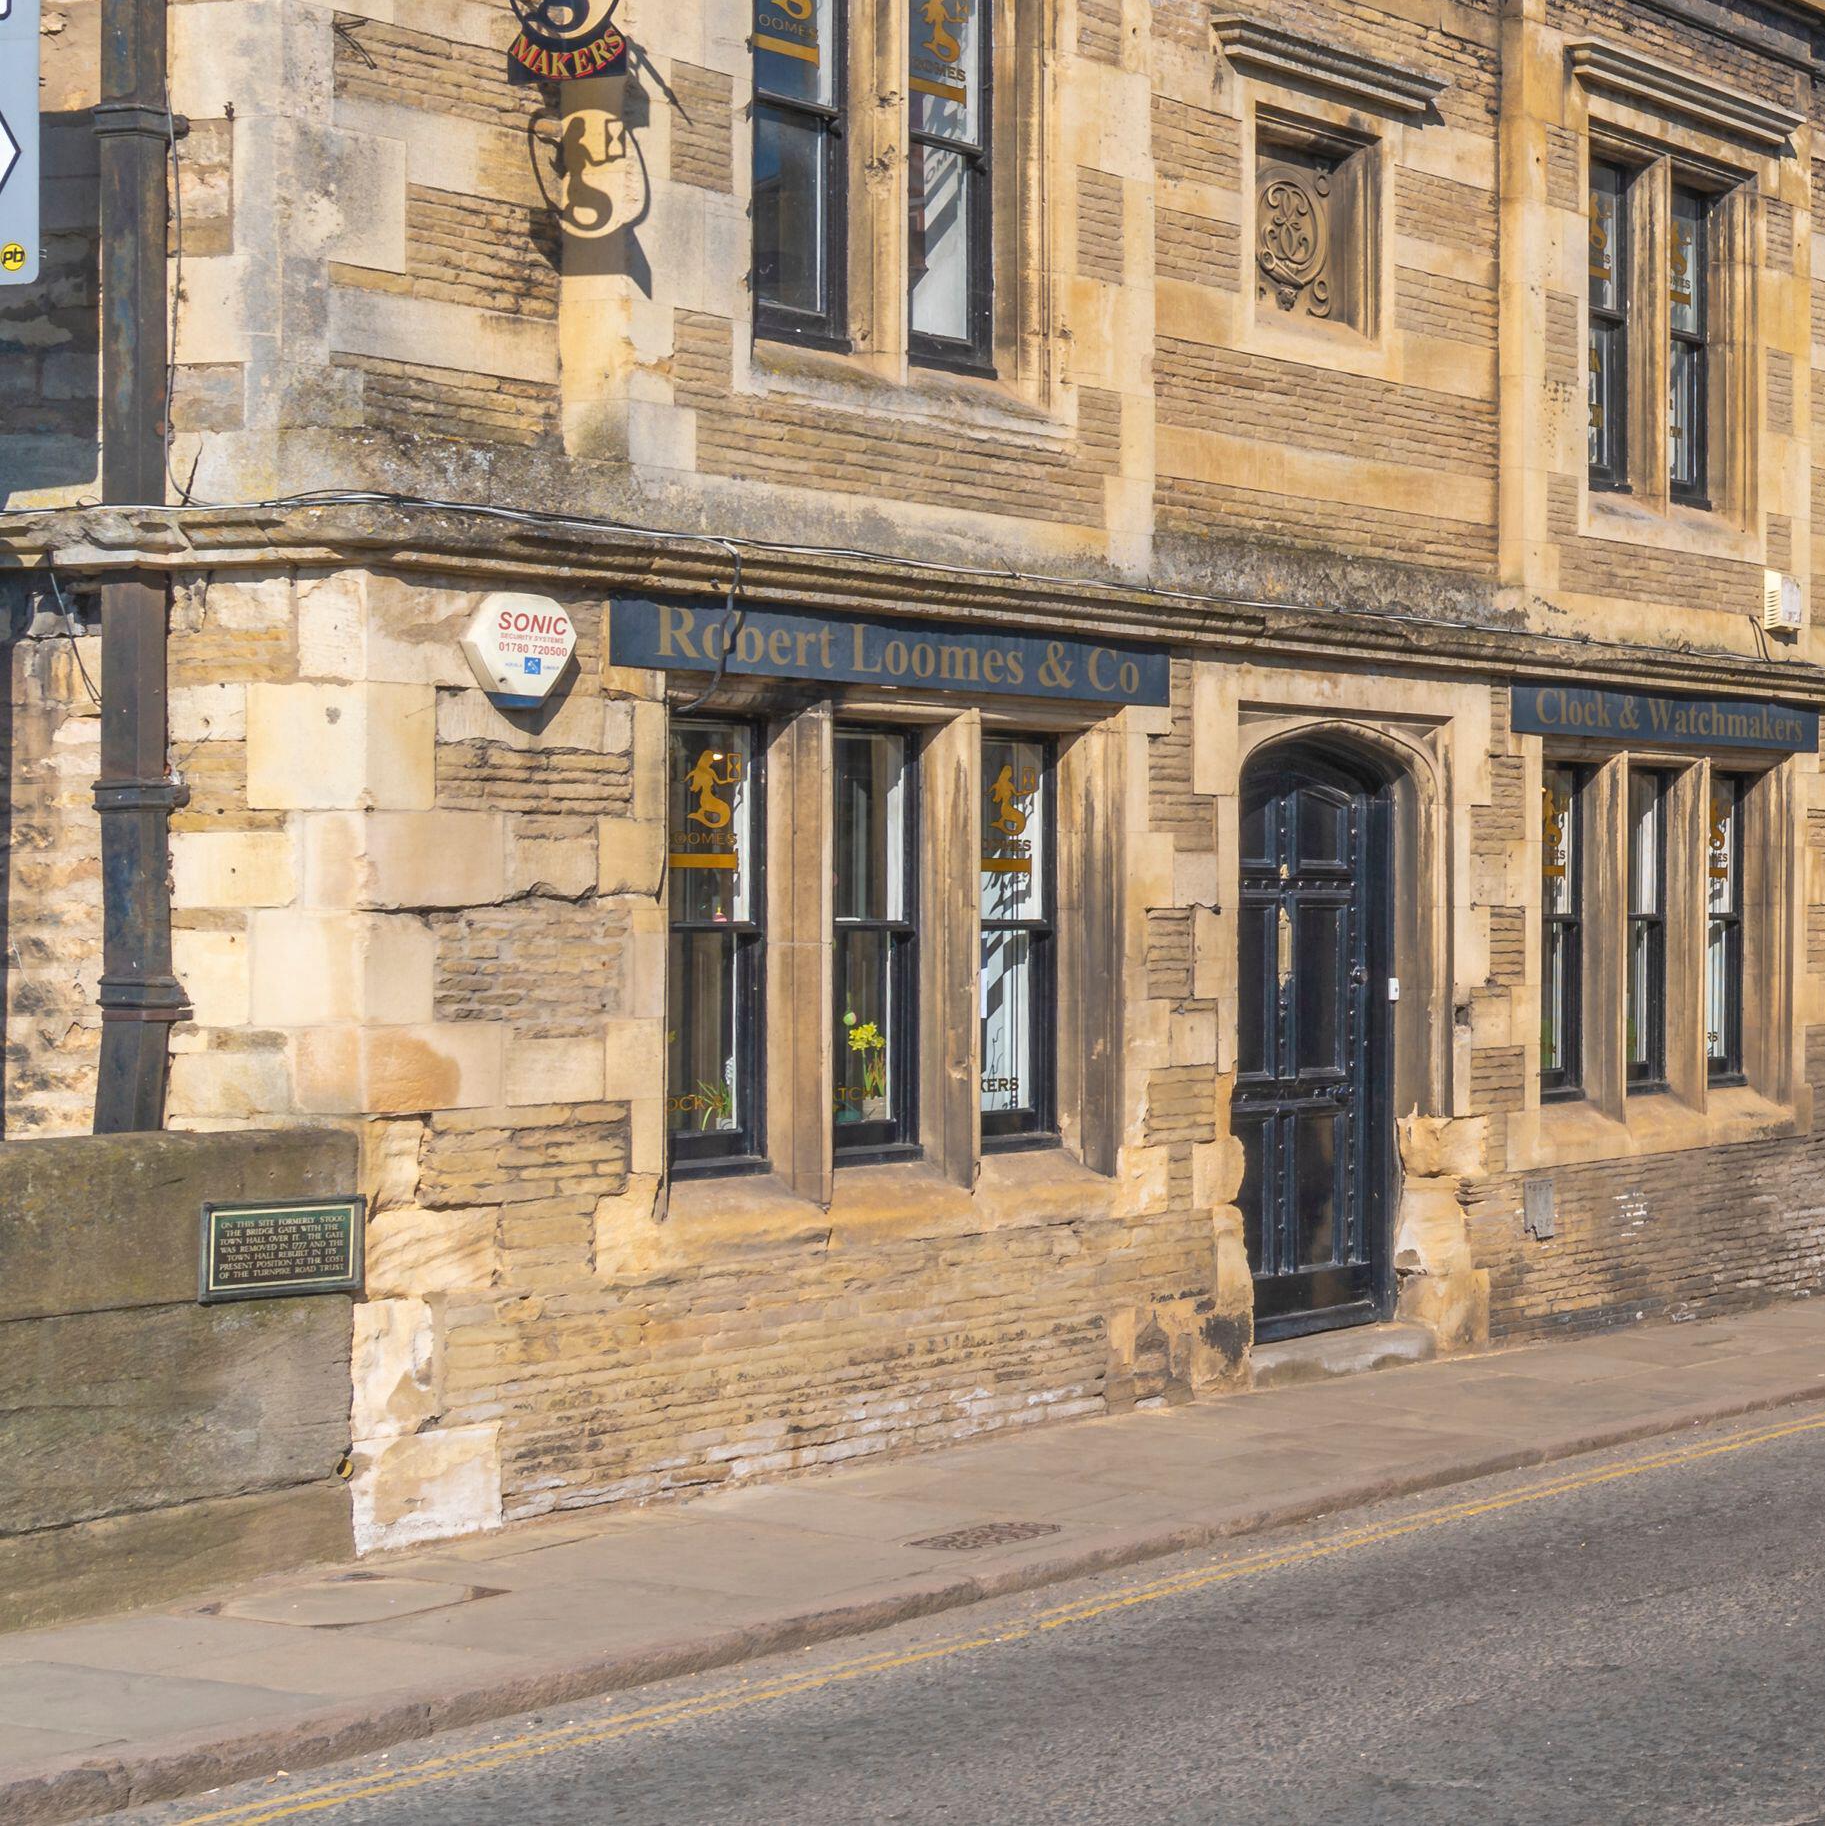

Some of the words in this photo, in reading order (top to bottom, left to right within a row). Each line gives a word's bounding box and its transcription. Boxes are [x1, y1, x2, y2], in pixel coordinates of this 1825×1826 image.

[758, 13, 819, 40] OOMES
[510, 27, 625, 80] MAKERS
[498, 611, 568, 636] SONIC
[500, 632, 533, 642] SECURITY
[534, 635, 565, 645] SYSTEMS
[498, 641, 529, 654] 01780
[532, 644, 568, 658] 720500
[654, 604, 836, 670] Robert
[850, 623, 1024, 685] Loomes
[1037, 640, 1075, 689] &
[1087, 646, 1140, 695] Co
[1535, 687, 1612, 728] Clock
[1619, 695, 1641, 731] &
[1648, 697, 1804, 742] Watchmakers
[980, 1077, 1019, 1093] KERS
[667, 1094, 706, 1112] OCK
[259, 1219, 274, 1227] SITE
[279, 1217, 315, 1225] FORMERLY
[320, 1215, 345, 1223] STOOD
[246, 1227, 274, 1236] BRIDGE
[278, 1226, 297, 1234] GATE
[246, 1236, 265, 1244] HALL
[269, 1234, 288, 1242] OVER
[325, 1231, 344, 1239] GATE
[220, 1246, 236, 1254] WAS
[240, 1244, 277, 1252] REMOVED
[309, 1240, 326, 1248] AND
[255, 1252, 274, 1260] HALL
[279, 1249, 309, 1257] REBUILT
[220, 1261, 254, 1271] PRESENT
[257, 1259, 293, 1267] POSITION
[325, 1255, 344, 1263] COST
[233, 1270, 249, 1278] THE
[253, 1268, 291, 1276] TURNPIKE
[320, 1263, 344, 1272] TRUST
